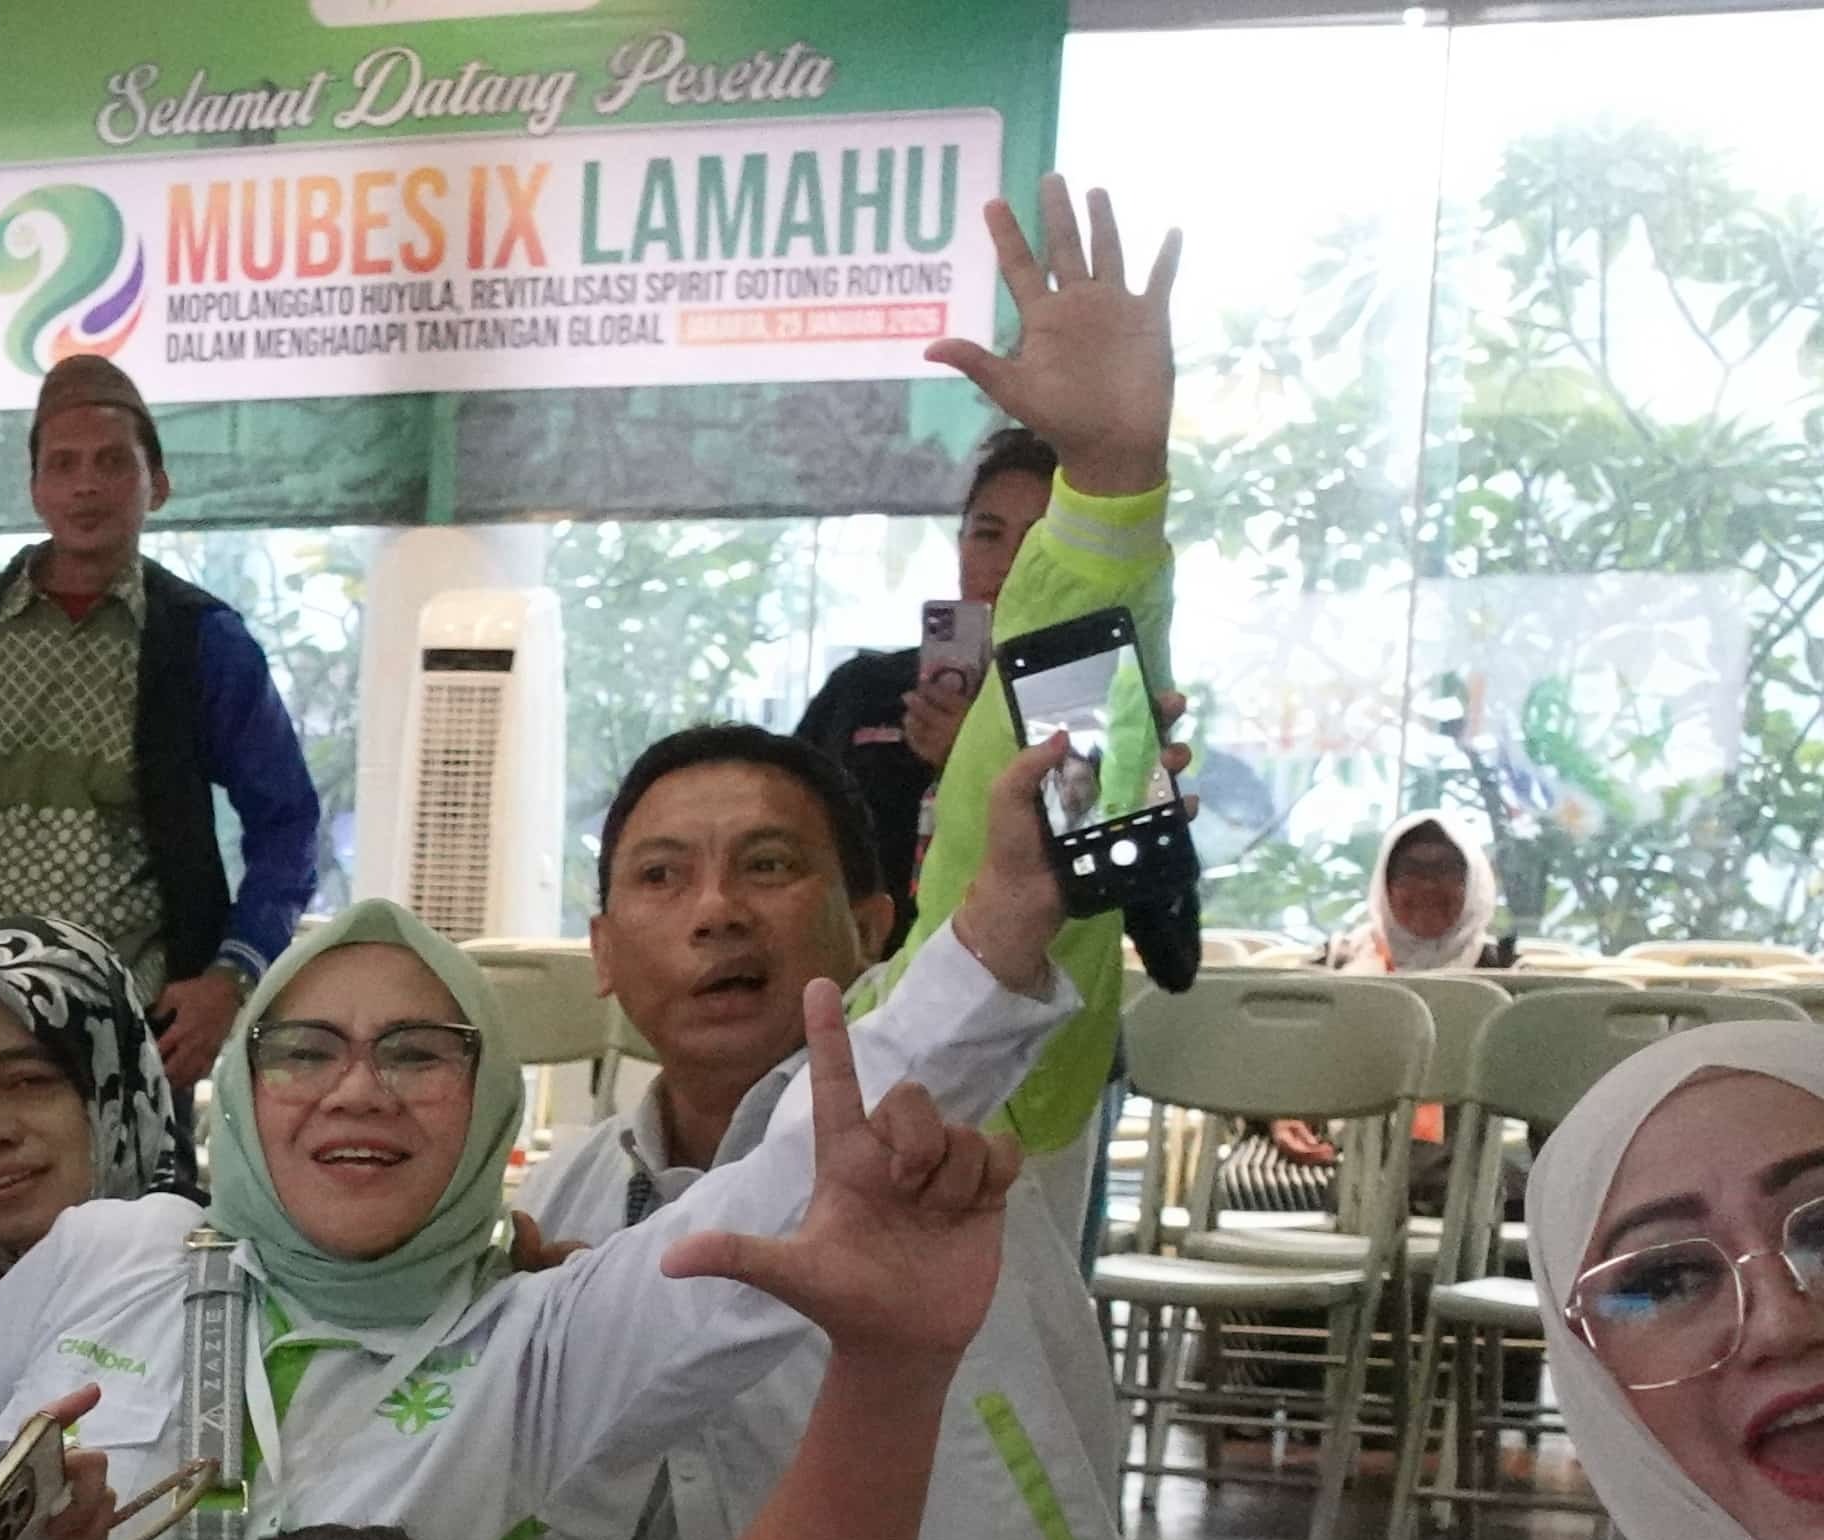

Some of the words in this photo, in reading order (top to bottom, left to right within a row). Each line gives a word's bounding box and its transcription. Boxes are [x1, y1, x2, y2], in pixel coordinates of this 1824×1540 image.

[95, 63, 334, 145] Selamat
[333, 46, 576, 137] Datang
[594, 30, 835, 114] Peserta
[167, 166, 449, 285] MUBES
[466, 163, 551, 270] IX
[581, 144, 959, 264] LAMAHU
[167, 285, 352, 323] MOPOLANGGATO
[470, 271, 640, 309] REVITALISASI
[645, 270, 728, 303] SPIRIT
[736, 267, 838, 300] GOTONG
[848, 262, 952, 295] ROYONG
[166, 332, 245, 363] DALAM
[254, 323, 408, 359] MENGHADAPI
[417, 316, 561, 353] TANTANGAN
[568, 312, 664, 347] GLOBAL
